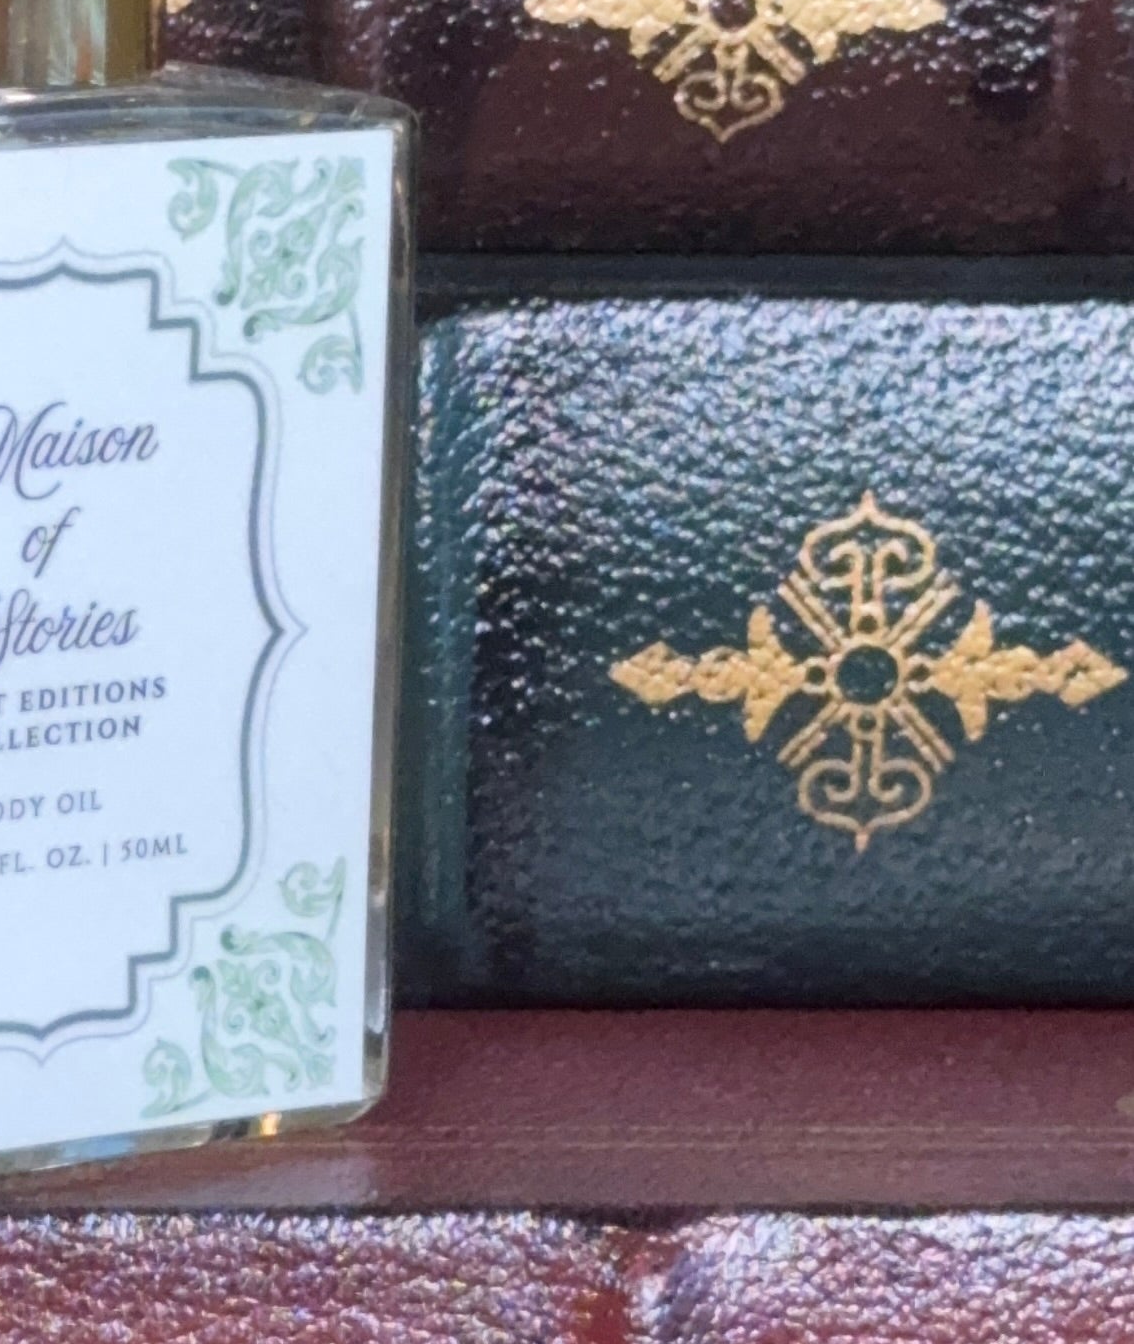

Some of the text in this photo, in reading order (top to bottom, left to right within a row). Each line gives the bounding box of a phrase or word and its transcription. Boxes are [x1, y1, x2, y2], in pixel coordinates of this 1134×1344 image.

[20, 505, 82, 578] of
[19, 676, 167, 712] EDITIONS
[56, 789, 103, 813] OIL
[45, 847, 91, 870] OZ.
[120, 833, 189, 863] 50ML
